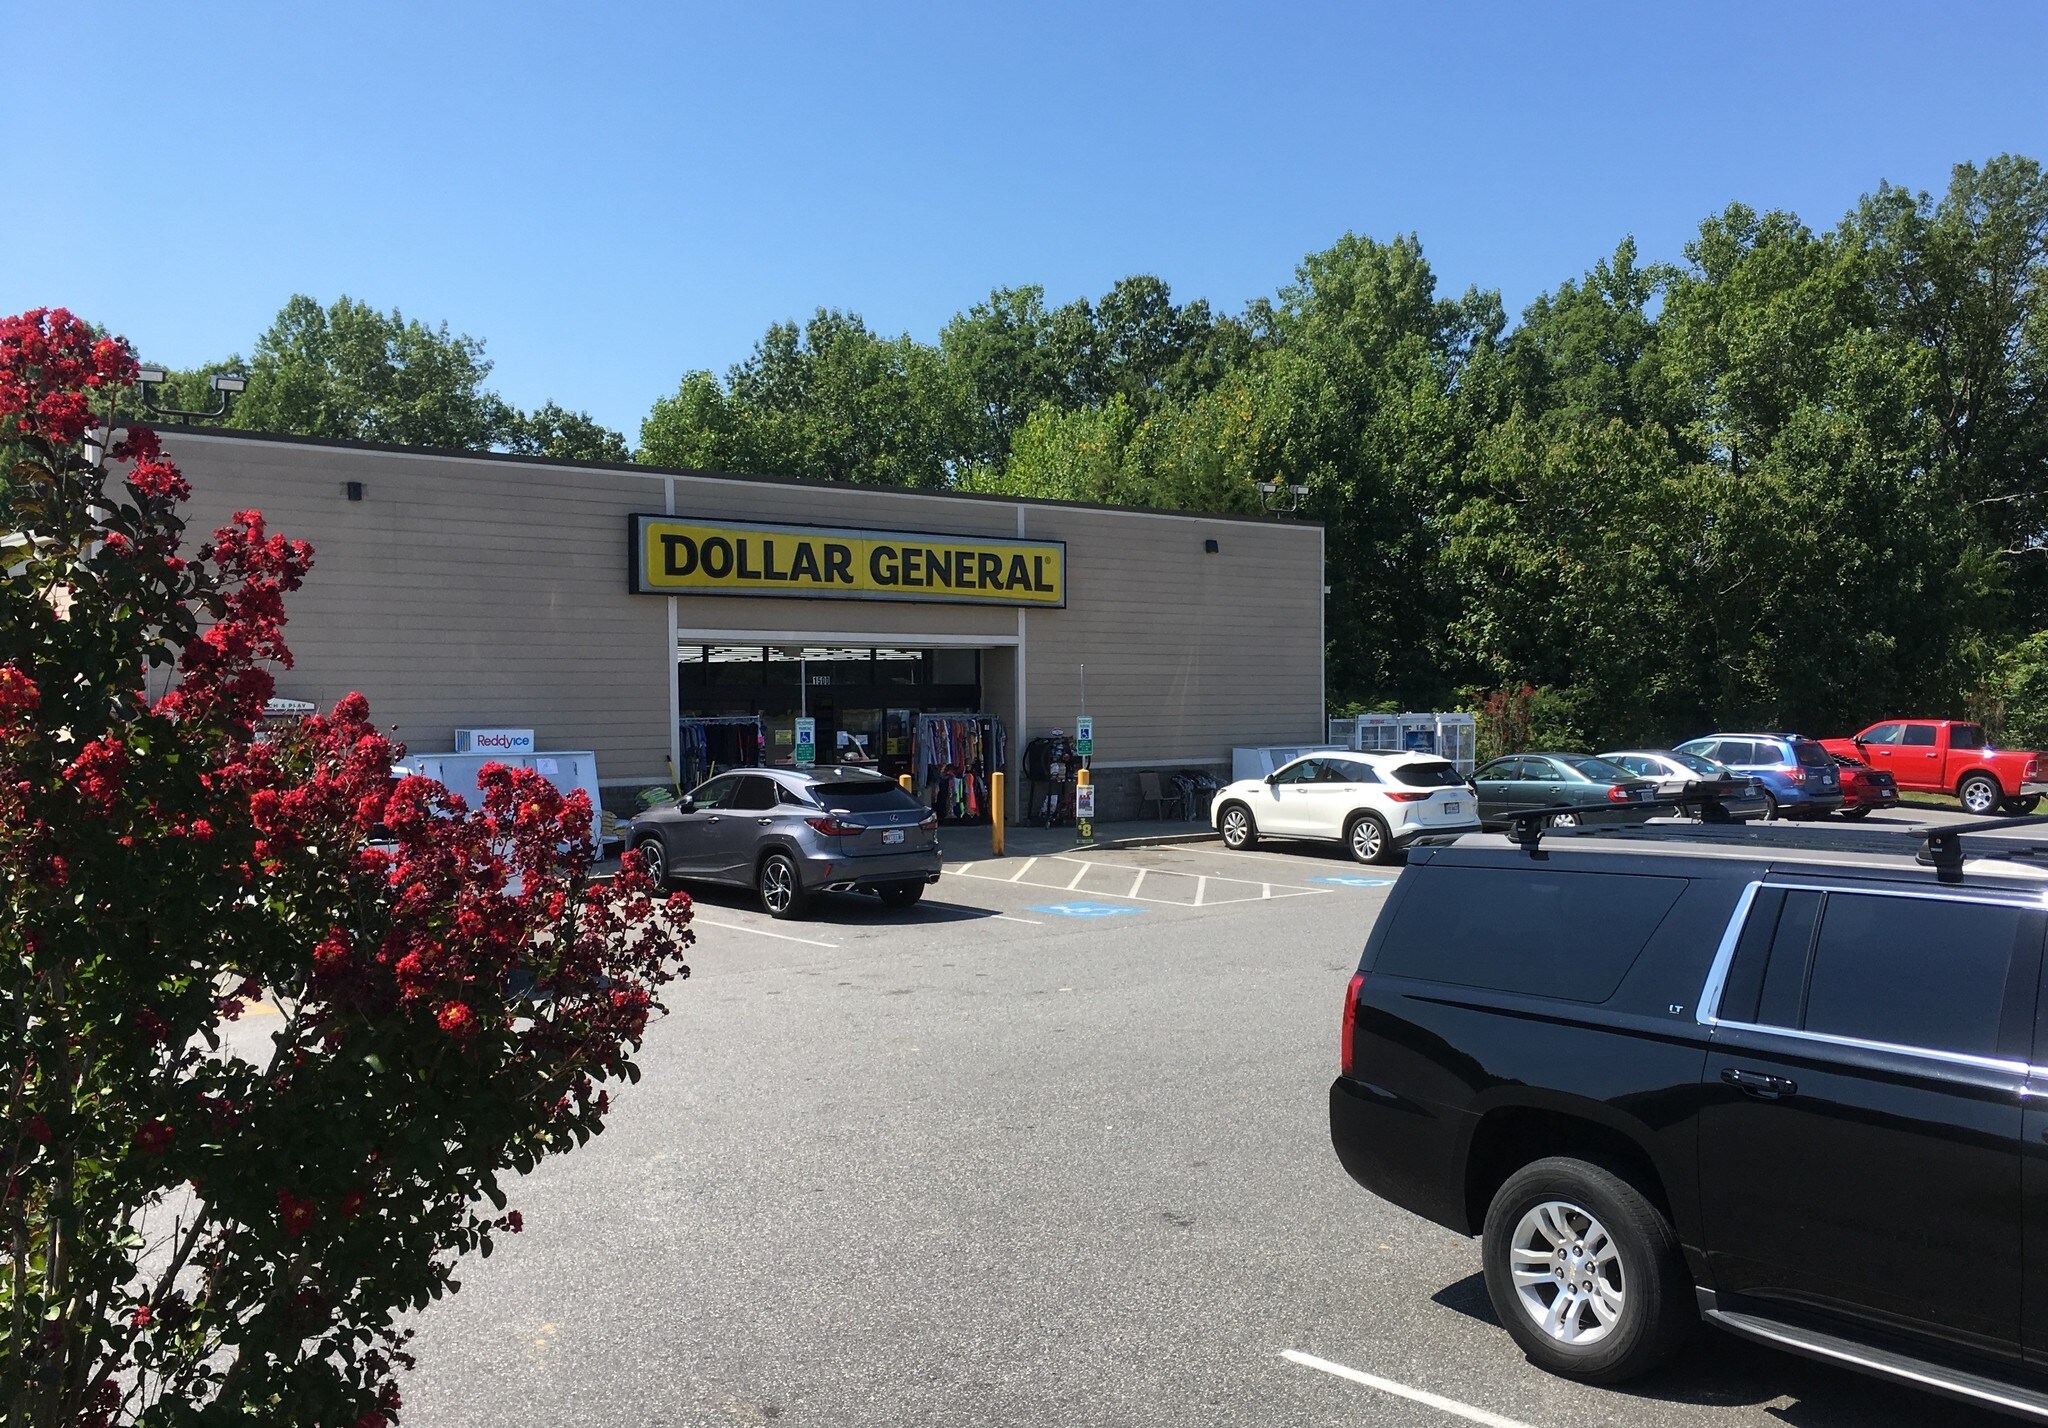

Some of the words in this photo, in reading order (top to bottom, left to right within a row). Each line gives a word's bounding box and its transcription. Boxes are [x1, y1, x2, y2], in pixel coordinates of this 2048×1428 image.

[660, 533, 854, 584] DOLLAR
[869, 545, 1054, 592] GENERAL
[1669, 1004, 1684, 1013] LT
